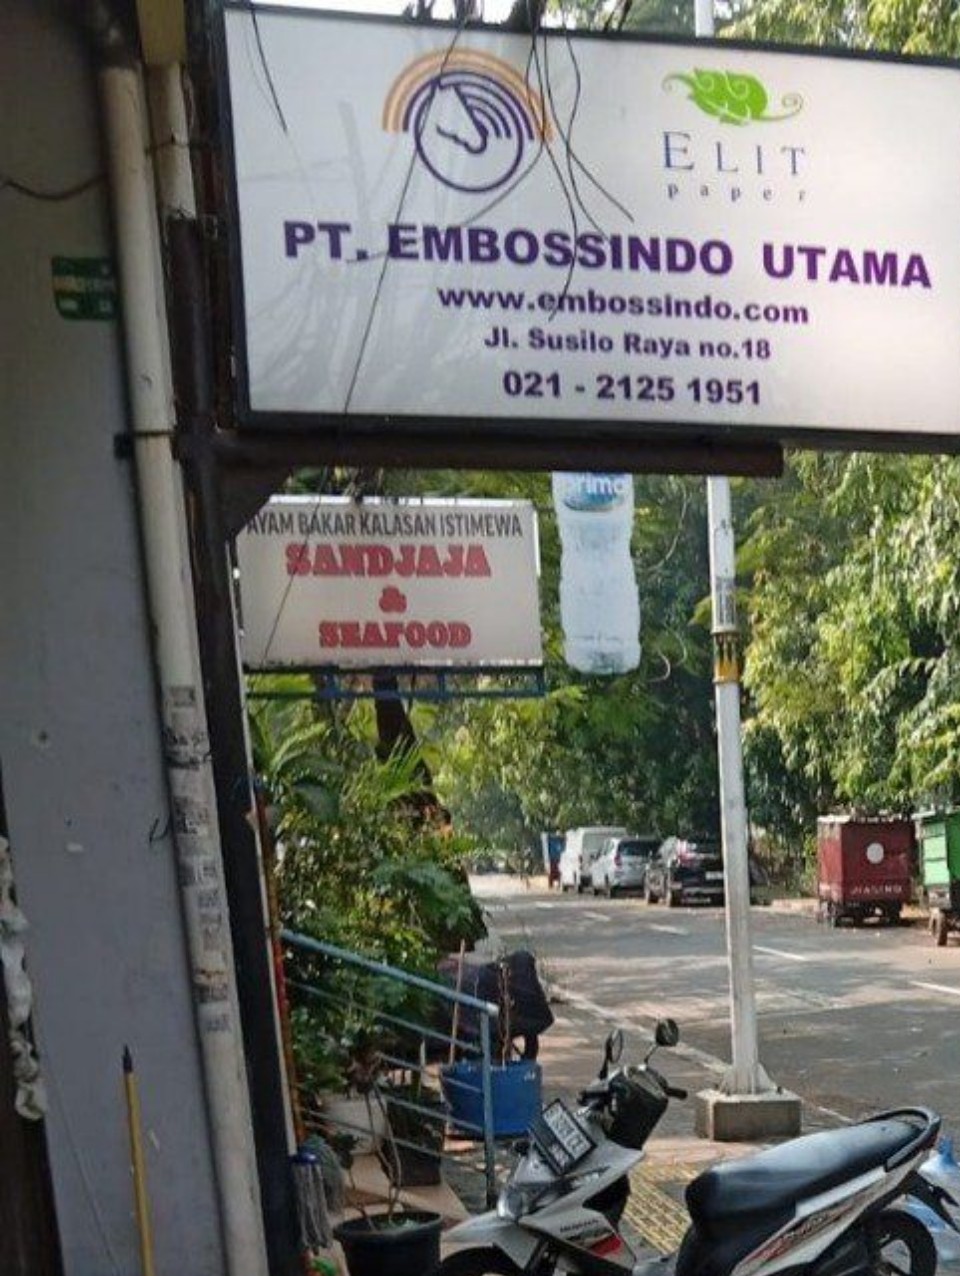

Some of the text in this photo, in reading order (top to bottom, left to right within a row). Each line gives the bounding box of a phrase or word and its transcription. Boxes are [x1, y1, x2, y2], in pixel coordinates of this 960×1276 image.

[663, 131, 805, 175] ELIT
[667, 183, 806, 202] paper
[284, 221, 932, 289] PT. EMBOSSINDO UTAMA
[438, 287, 810, 324] www.embossindo.com
[529, 329, 615, 353] Susilo
[624, 333, 691, 359] Raya
[700, 338, 771, 360] no.18
[503, 370, 562, 398] 021
[597, 372, 676, 402] 2125
[687, 377, 762, 405] 1951
[300, 512, 357, 537] BAKAR
[360, 512, 436, 537] KALASAN
[440, 513, 524, 537] ISTIMEWA
[286, 543, 492, 578] SANDJAJA
[379, 586, 408, 613] &
[319, 621, 472, 649] SEAFOOD
